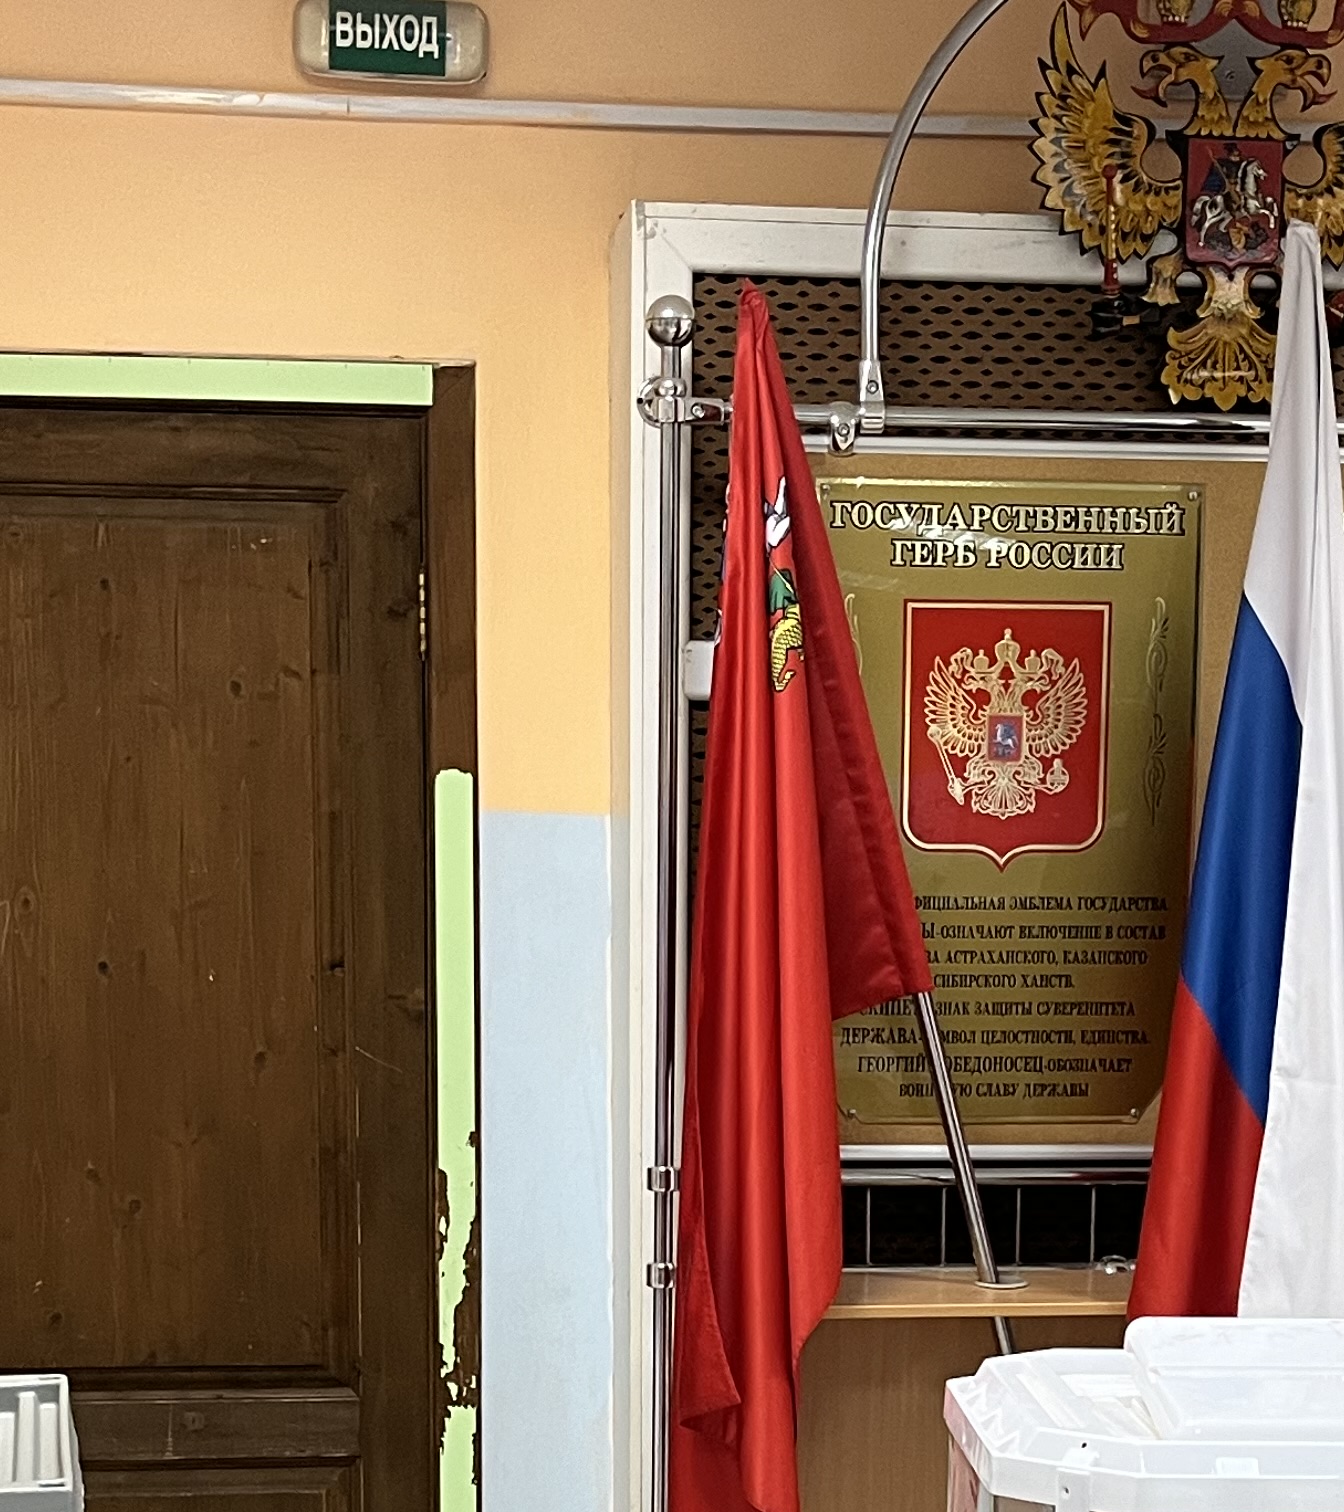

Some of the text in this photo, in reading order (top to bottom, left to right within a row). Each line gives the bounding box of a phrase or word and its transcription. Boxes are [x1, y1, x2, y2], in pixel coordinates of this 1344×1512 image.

[336, 11, 439, 59] ВЫХОД
[830, 501, 1186, 536] ГОСУДАРСТВЕННЫЙ
[890, 538, 1124, 570] ГЕРБ РОССИИ
[915, 896, 1168, 913] ФИЦИАЛЬНАЯ ЭМБЛЕМА ГОСУДАРСТВА
[921, 922, 1166, 940] Ы-ОЗНАЧАЮТ ВКЛЮЧЕНИЕ В СОСТАВ
[944, 950, 1058, 966] АСТРАХАНСКОГО,
[1063, 950, 1148, 965] КАЗАНСКОГО
[933, 974, 1017, 988] СИБИРСКОГО
[974, 1001, 1033, 1017] ЗАЩИТЫ
[1036, 1001, 1136, 1016] СУВЕРЕНИТЕТА
[981, 1029, 1076, 1046] ЦЕЛОСТНОСТИ,
[858, 1053, 1133, 1075] ГЕОРГИЙ ОБЕДОНОСЕЦ-ОБОЗНАЧАЕТ
[975, 1083, 1019, 1098] СЛАВУ
[1023, 1083, 1089, 1099] ДЕРЖАВЫ
